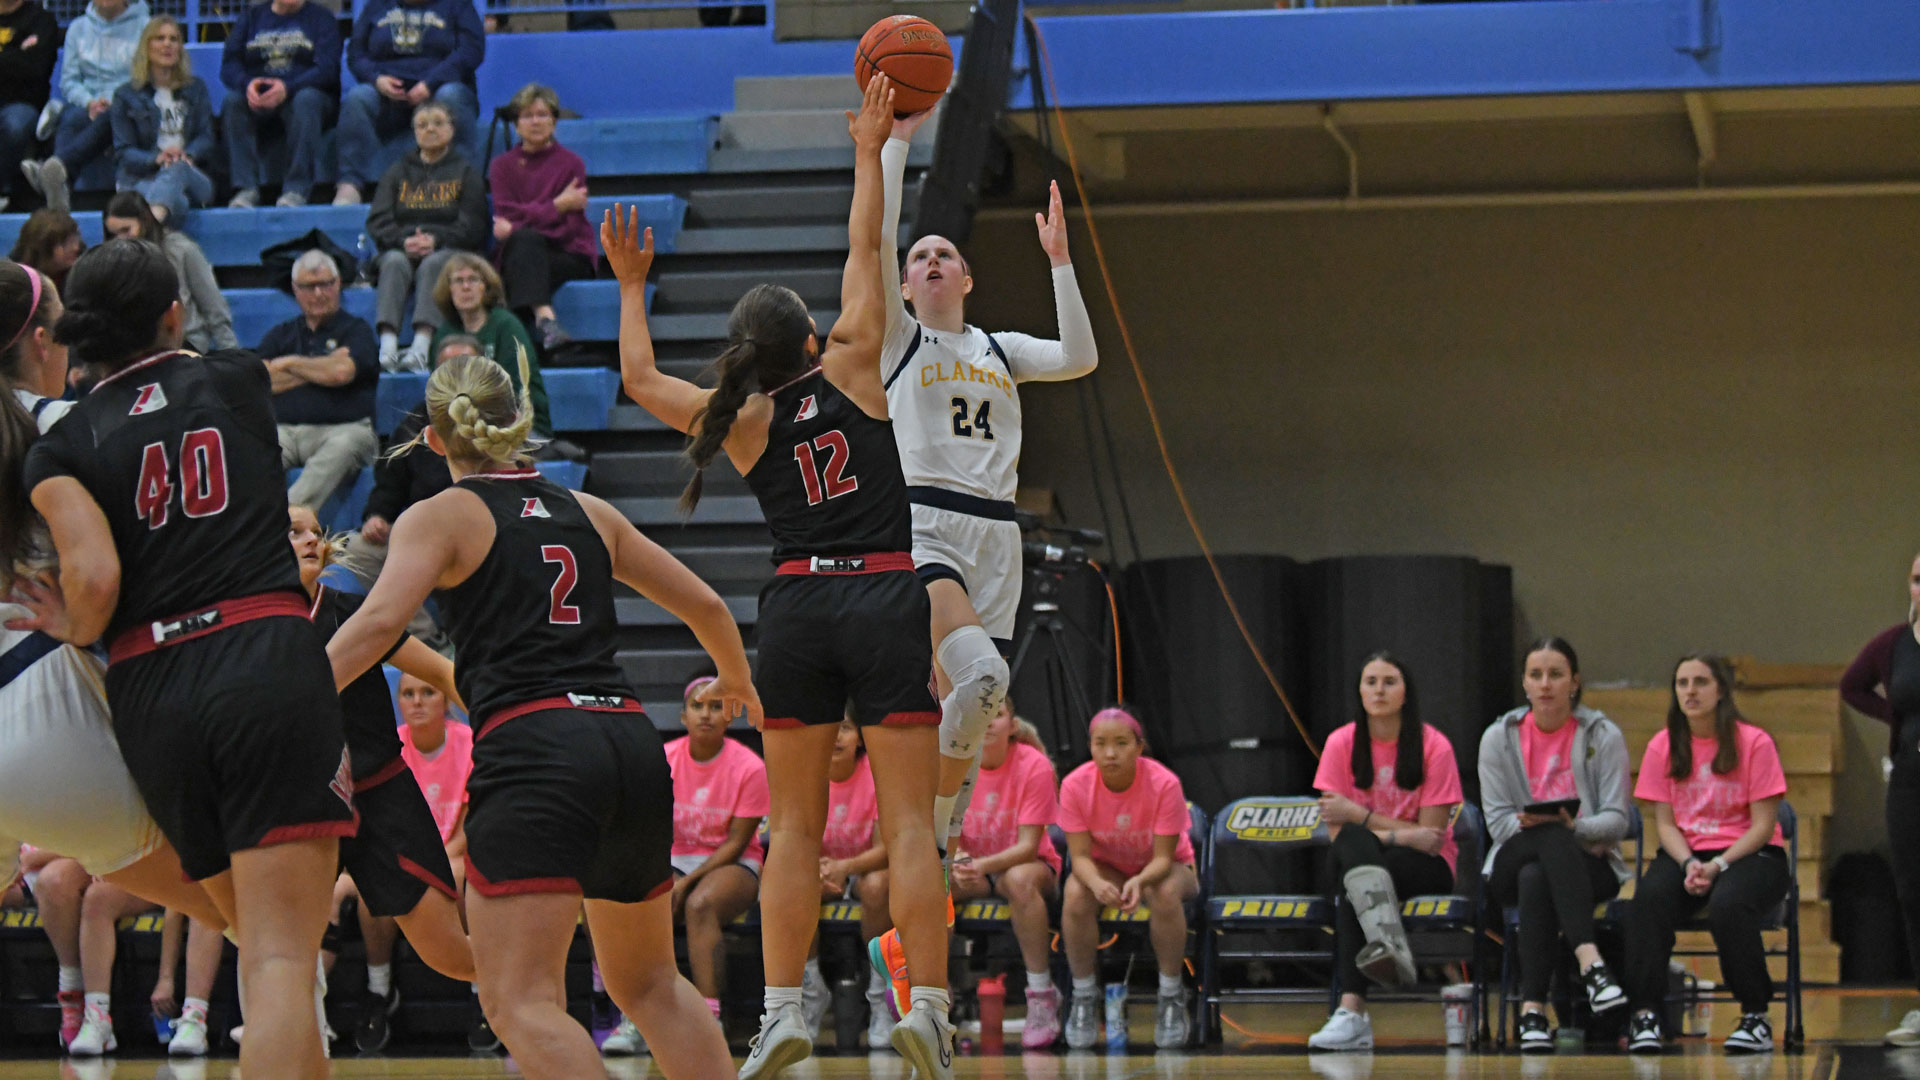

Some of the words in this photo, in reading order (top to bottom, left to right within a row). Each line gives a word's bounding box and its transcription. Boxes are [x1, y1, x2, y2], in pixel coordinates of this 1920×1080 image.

[948, 394, 996, 442] 24
[134, 427, 229, 530] 40
[794, 429, 859, 507] 12
[541, 544, 581, 624] 2
[1230, 806, 1320, 829] CLARKE
[1221, 901, 1310, 917] PRIDE
